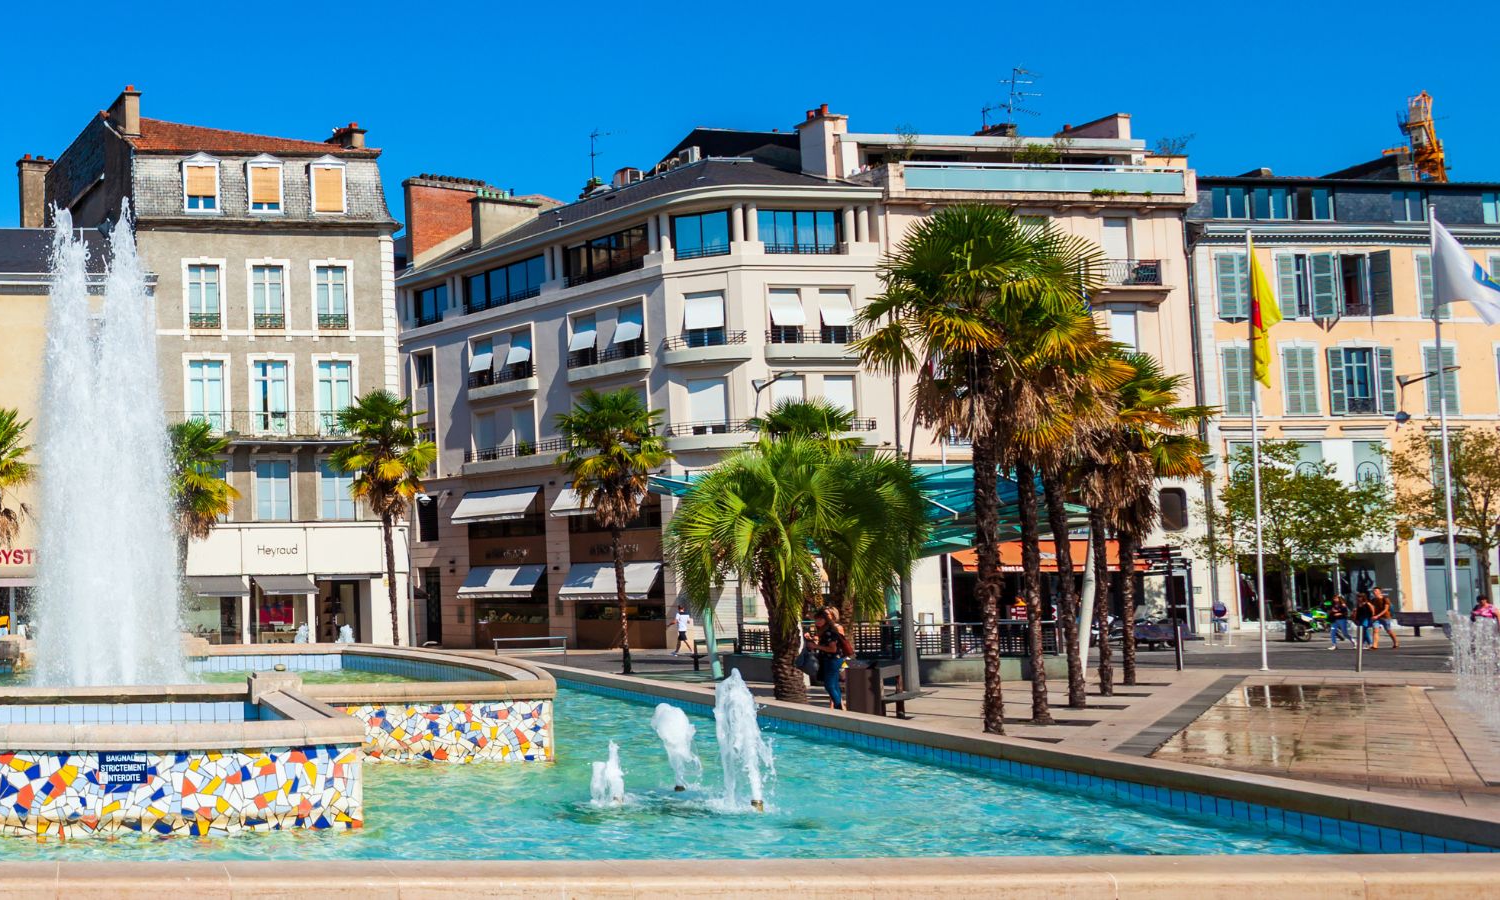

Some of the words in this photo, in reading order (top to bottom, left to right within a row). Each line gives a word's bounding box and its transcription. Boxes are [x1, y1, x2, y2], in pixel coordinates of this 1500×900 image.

[257, 543, 298, 557] Heyraud
[100, 763, 146, 772] STRICTEMENT
[108, 773, 141, 782] NTERDITE
